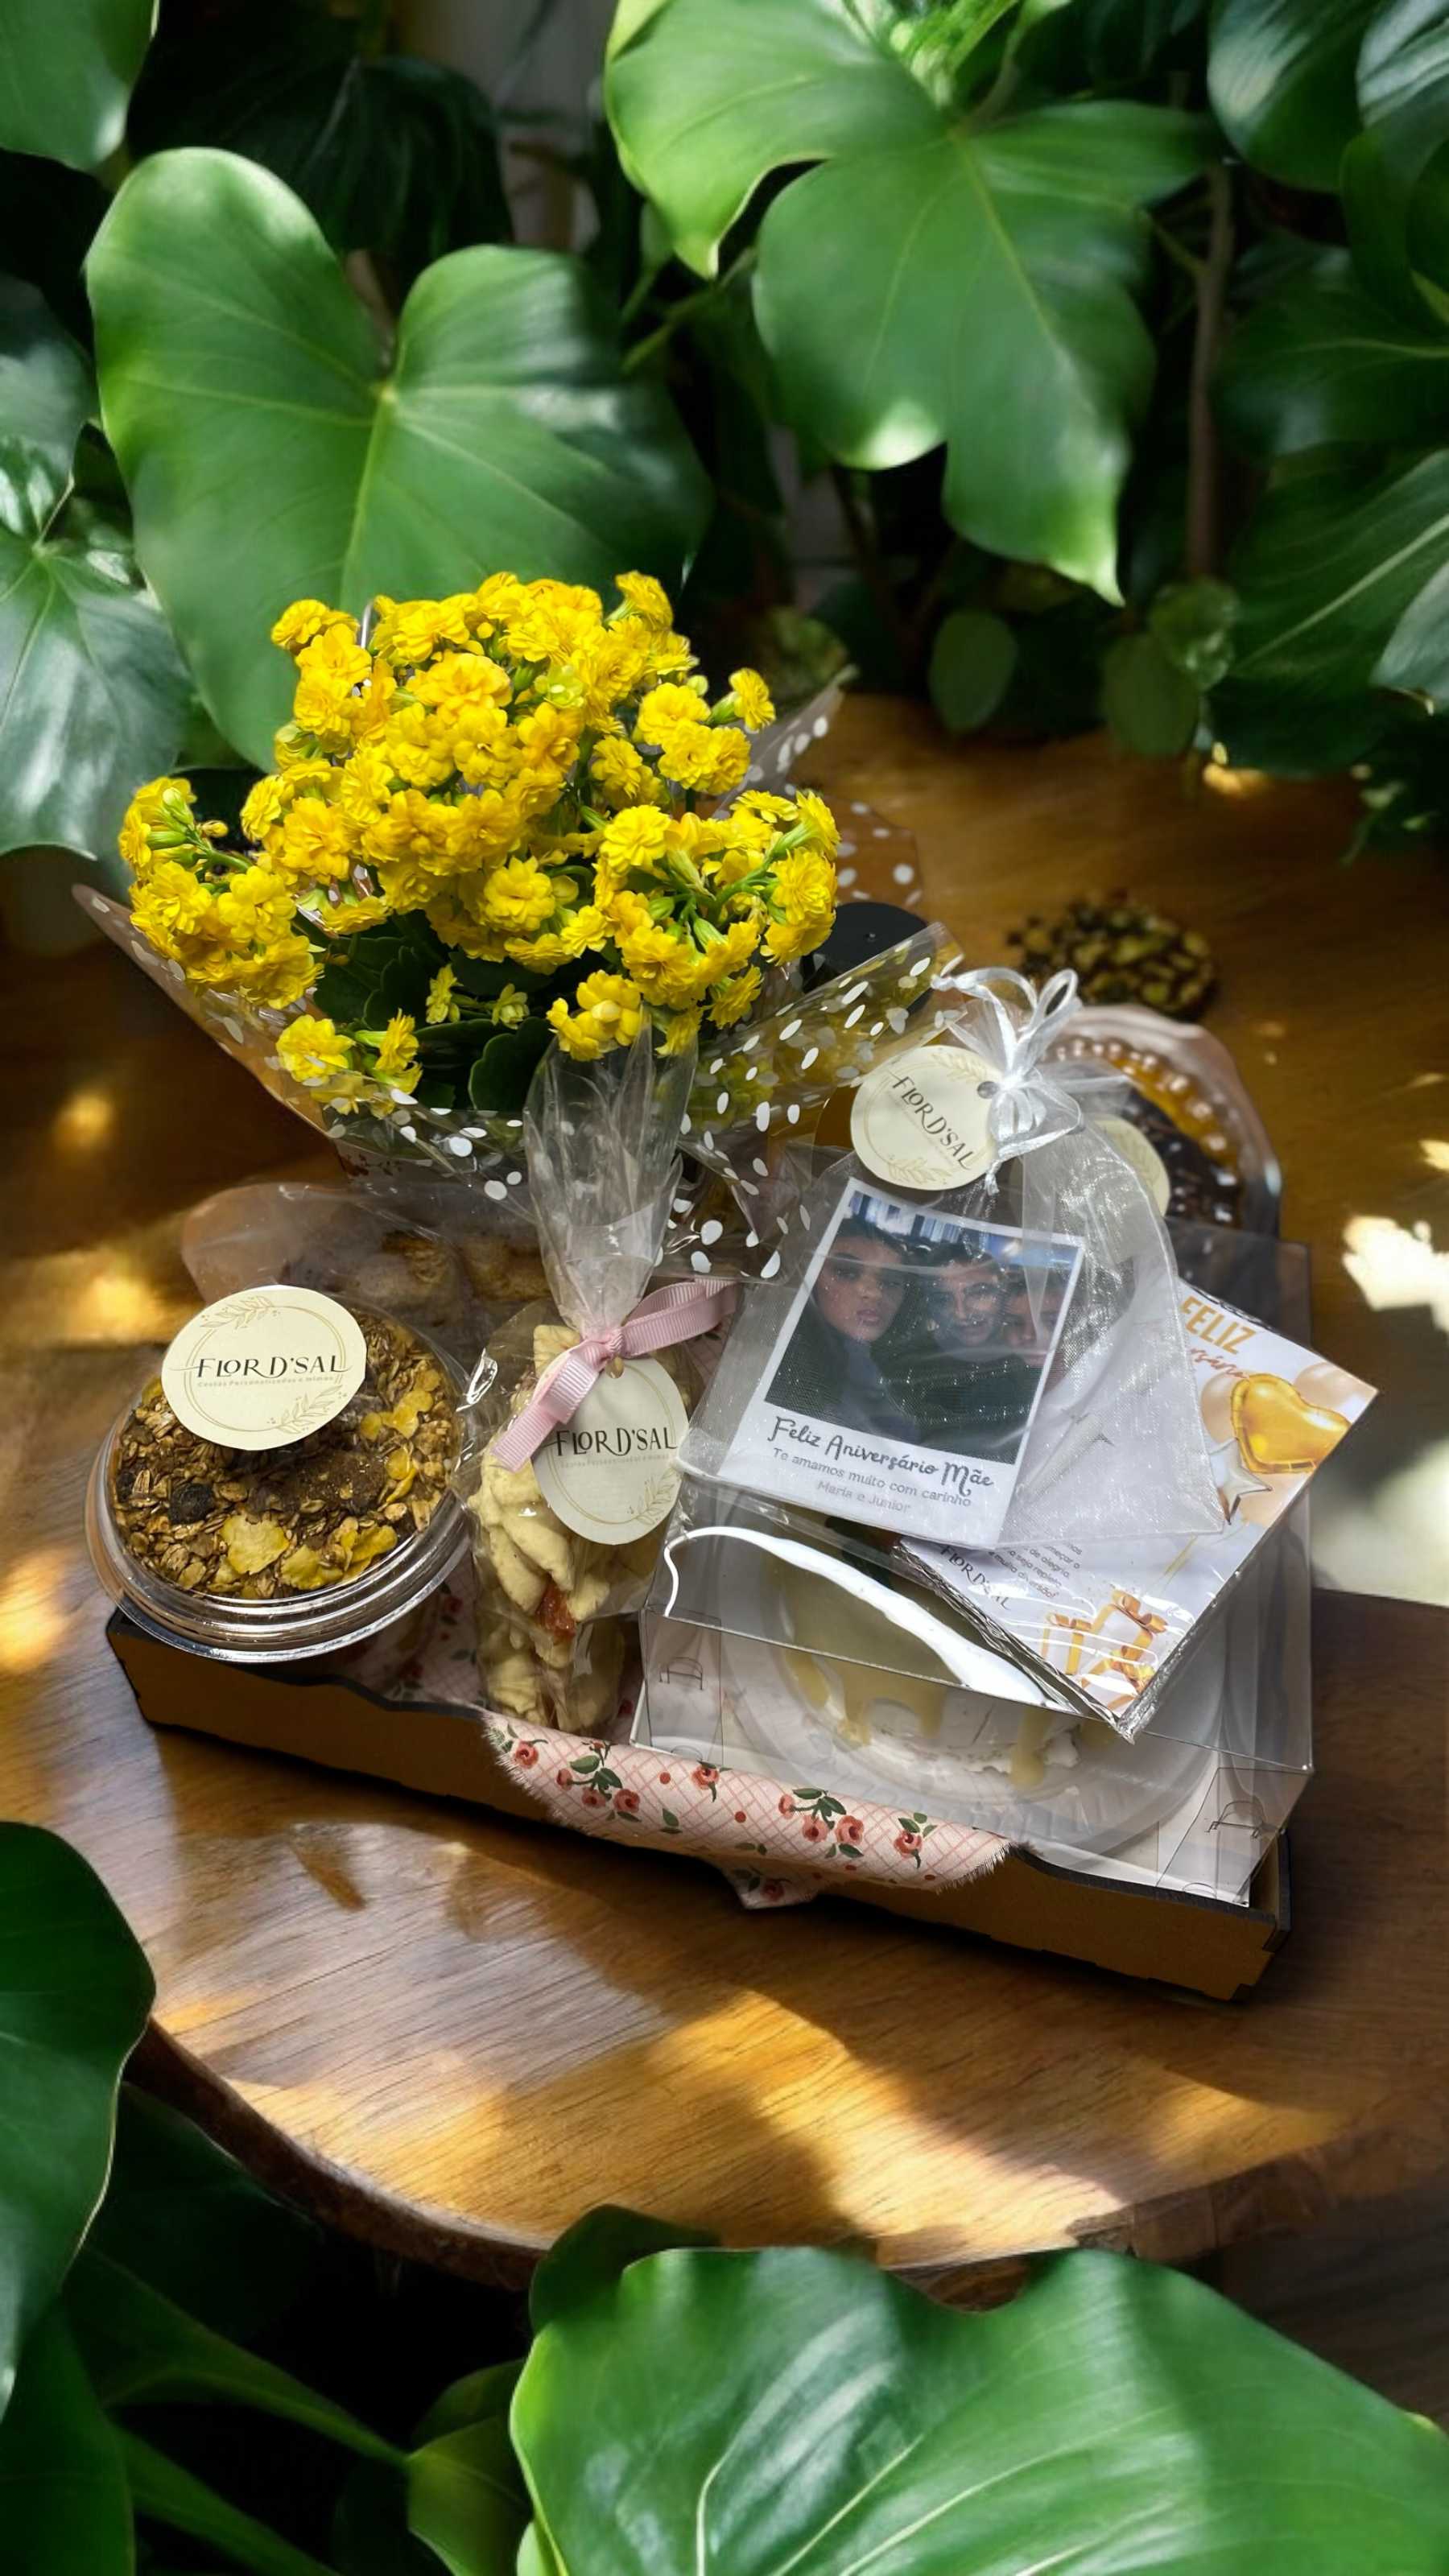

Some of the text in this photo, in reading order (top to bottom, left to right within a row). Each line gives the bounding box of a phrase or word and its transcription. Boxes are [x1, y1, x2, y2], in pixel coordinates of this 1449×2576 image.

[889, 1070, 934, 1129] FLOR
[924, 1116, 972, 1170] D'SAL
[177, 1355, 352, 1379] FLOR D'SAL
[547, 1427, 678, 1456] FLOR D'SAL
[767, 1415, 994, 1497] Feliz Aniversário Mãe
[774, 1447, 972, 1507] Te amamos muito com carinho
[818, 1480, 852, 1499] Maria
[857, 1492, 865, 1502] e
[938, 1545, 975, 1583] FLOR
[994, 1554, 1018, 1573] muita
[1016, 1554, 1034, 1568] seja
[1030, 1548, 1041, 1558] de
